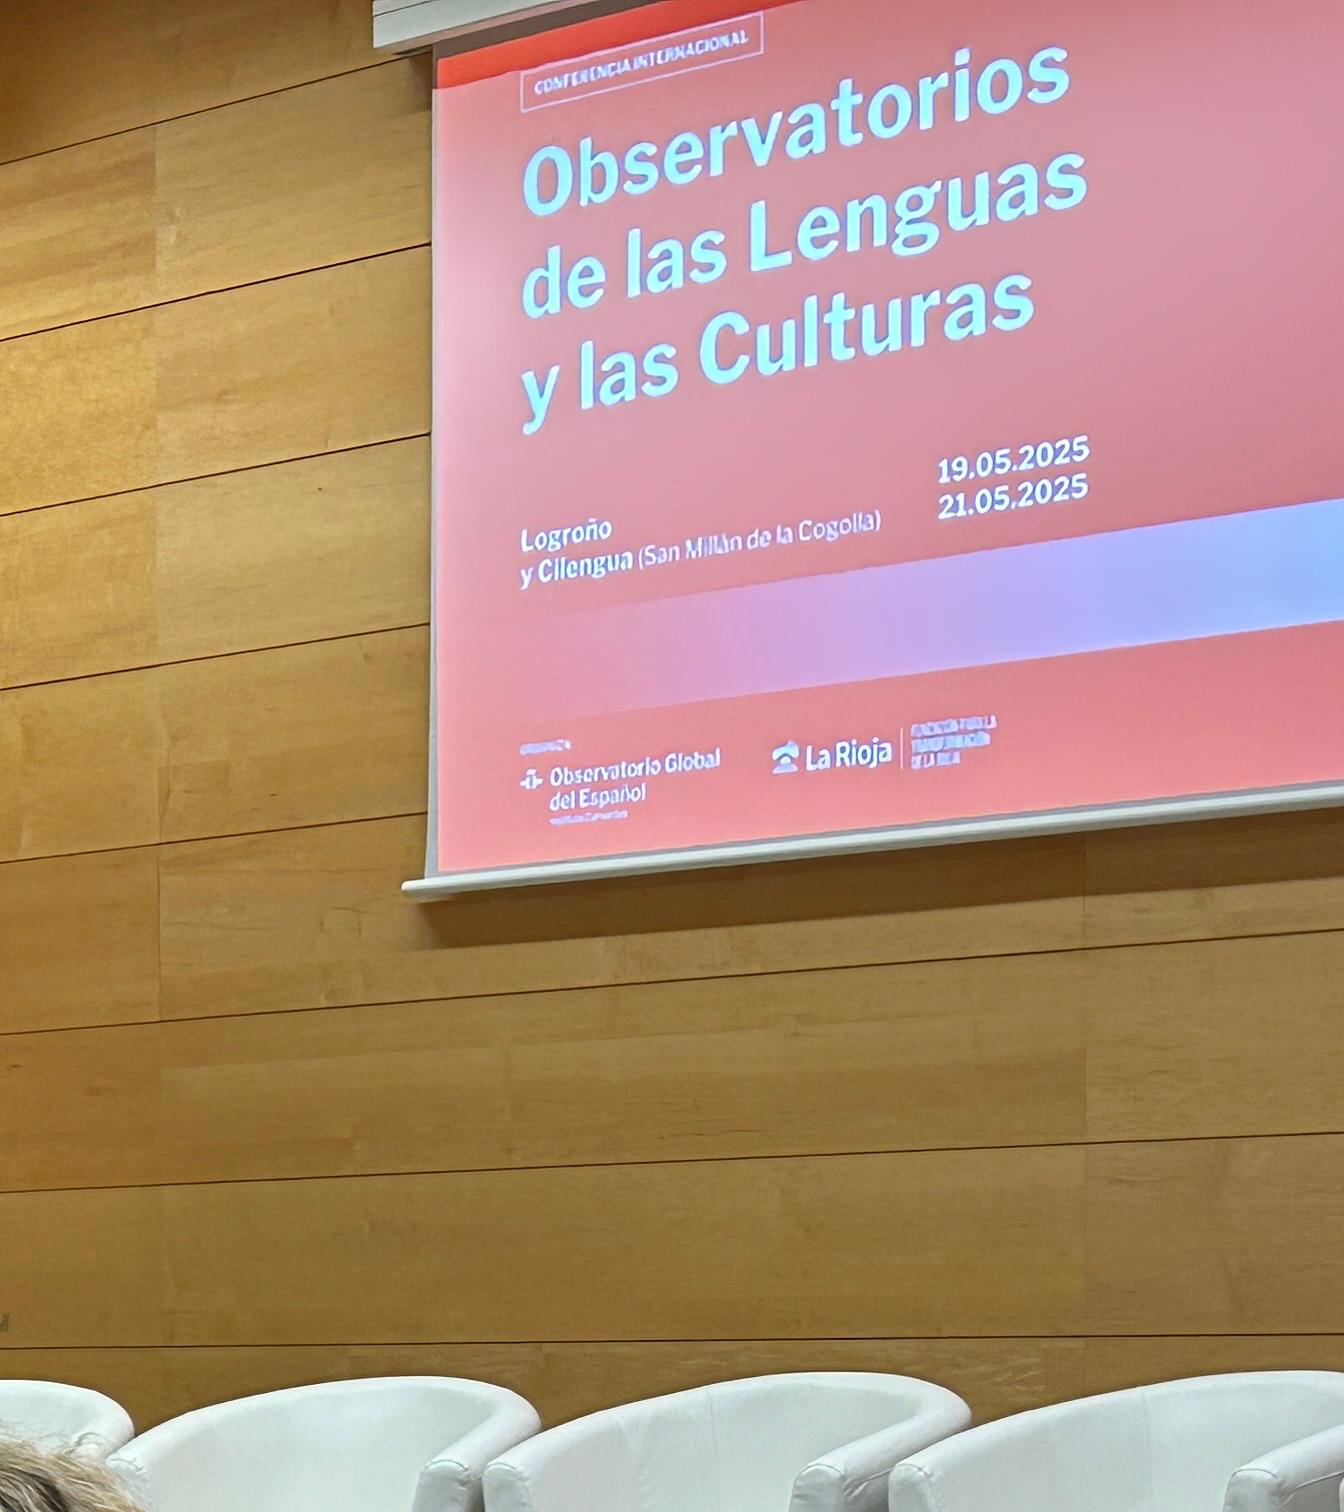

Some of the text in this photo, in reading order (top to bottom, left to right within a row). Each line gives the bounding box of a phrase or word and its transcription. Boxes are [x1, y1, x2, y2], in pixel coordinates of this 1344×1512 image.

[523, 45, 1071, 217] Observatorios
[522, 151, 1089, 319] de las Lenguas
[521, 273, 1036, 436] y las Culturas
[938, 434, 1091, 484] 19.05.2025
[937, 472, 1090, 520] 21.05.2025
[519, 567, 534, 591] y
[638, 544, 681, 571] (San
[746, 529, 773, 550] de
[776, 524, 794, 545] la
[798, 510, 882, 542] Cogolla)
[520, 518, 613, 552] Logroño
[549, 748, 722, 788] Observatorio Global
[805, 744, 831, 772] La
[835, 736, 894, 769] Rioja
[548, 782, 648, 812] del Español
